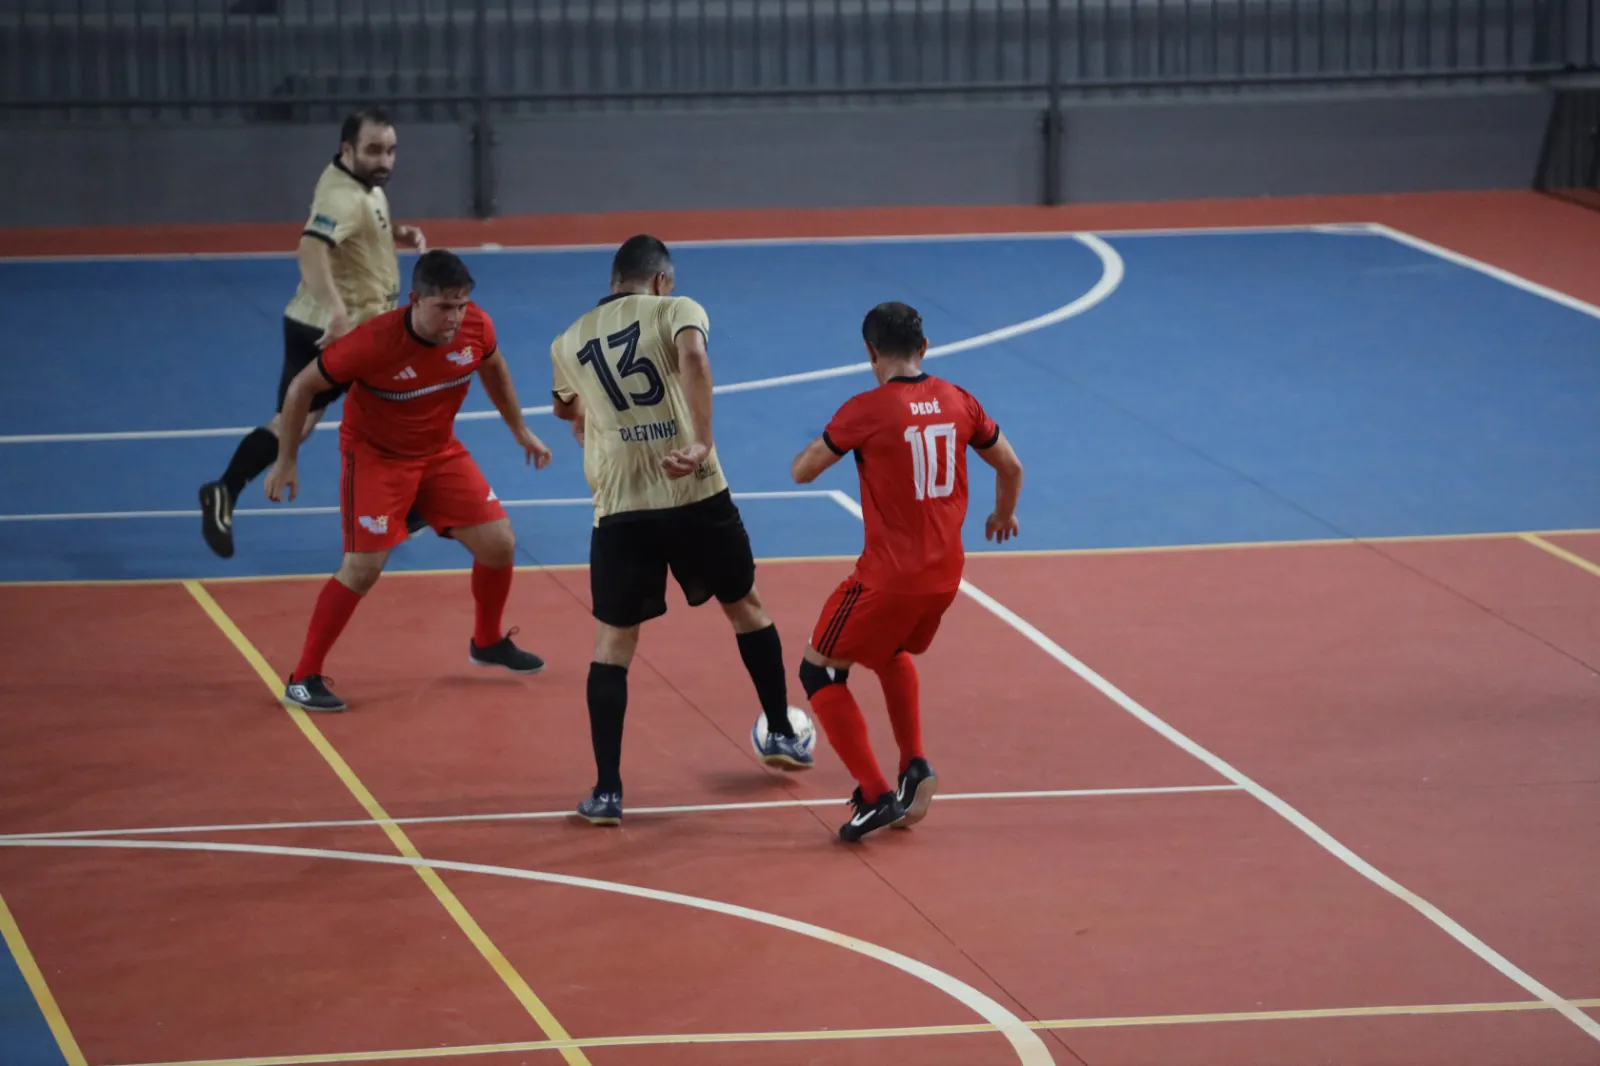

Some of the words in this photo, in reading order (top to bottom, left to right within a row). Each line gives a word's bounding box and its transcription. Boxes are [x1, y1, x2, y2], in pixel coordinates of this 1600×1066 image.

[577, 320, 665, 411] 13
[909, 398, 941, 415] DEDÉ
[904, 422, 956, 500] 10
